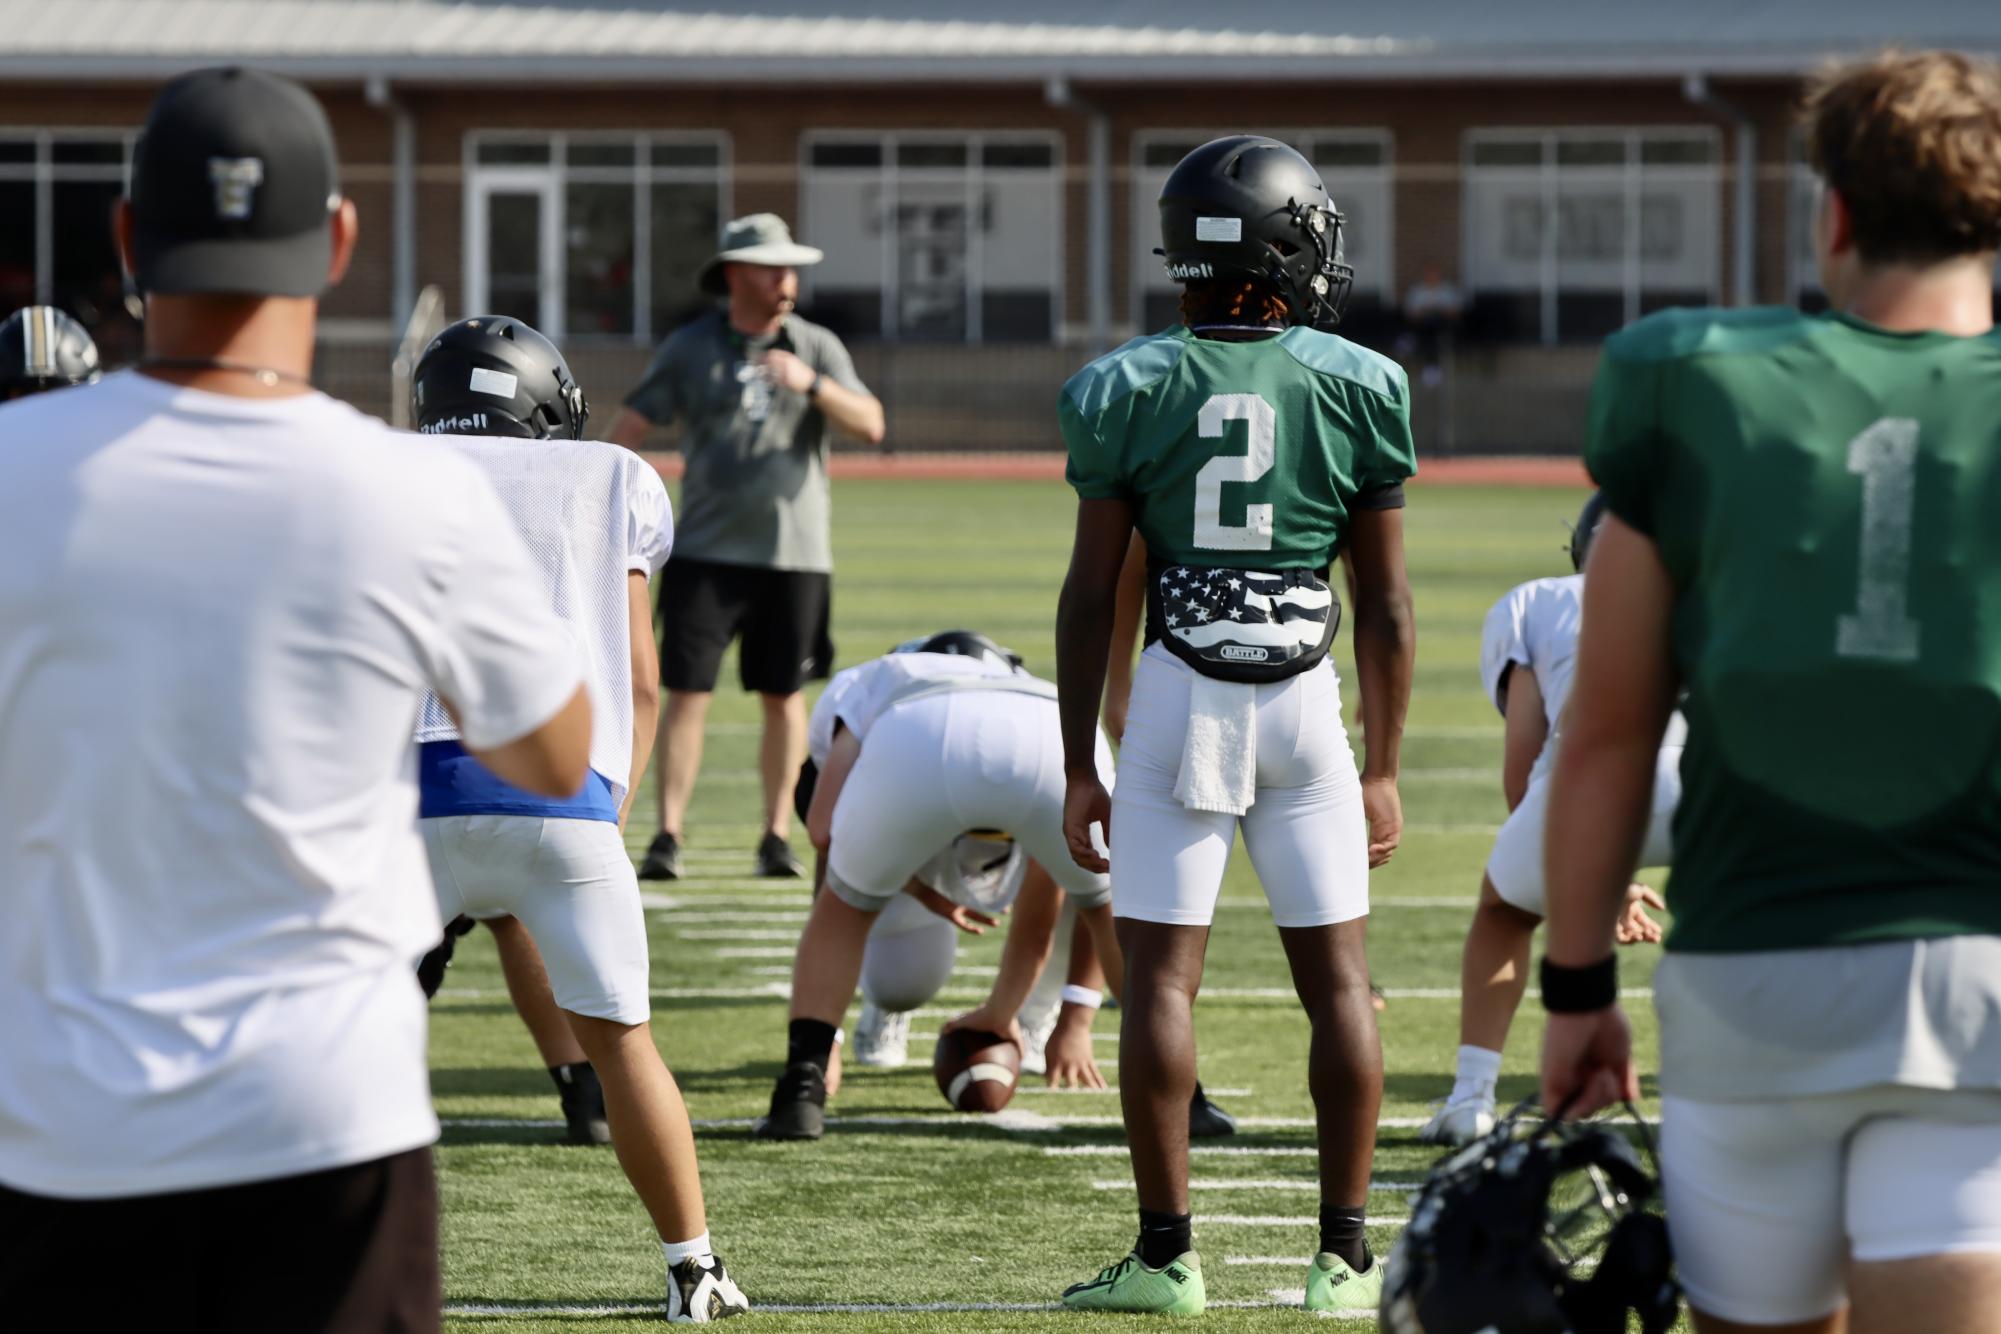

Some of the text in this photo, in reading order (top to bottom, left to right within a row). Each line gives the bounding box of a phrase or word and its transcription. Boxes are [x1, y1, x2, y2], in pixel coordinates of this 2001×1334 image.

[1193, 393, 1276, 551] 2
[1836, 417, 1919, 660] 1
[1163, 1266, 1190, 1285] NIKE
